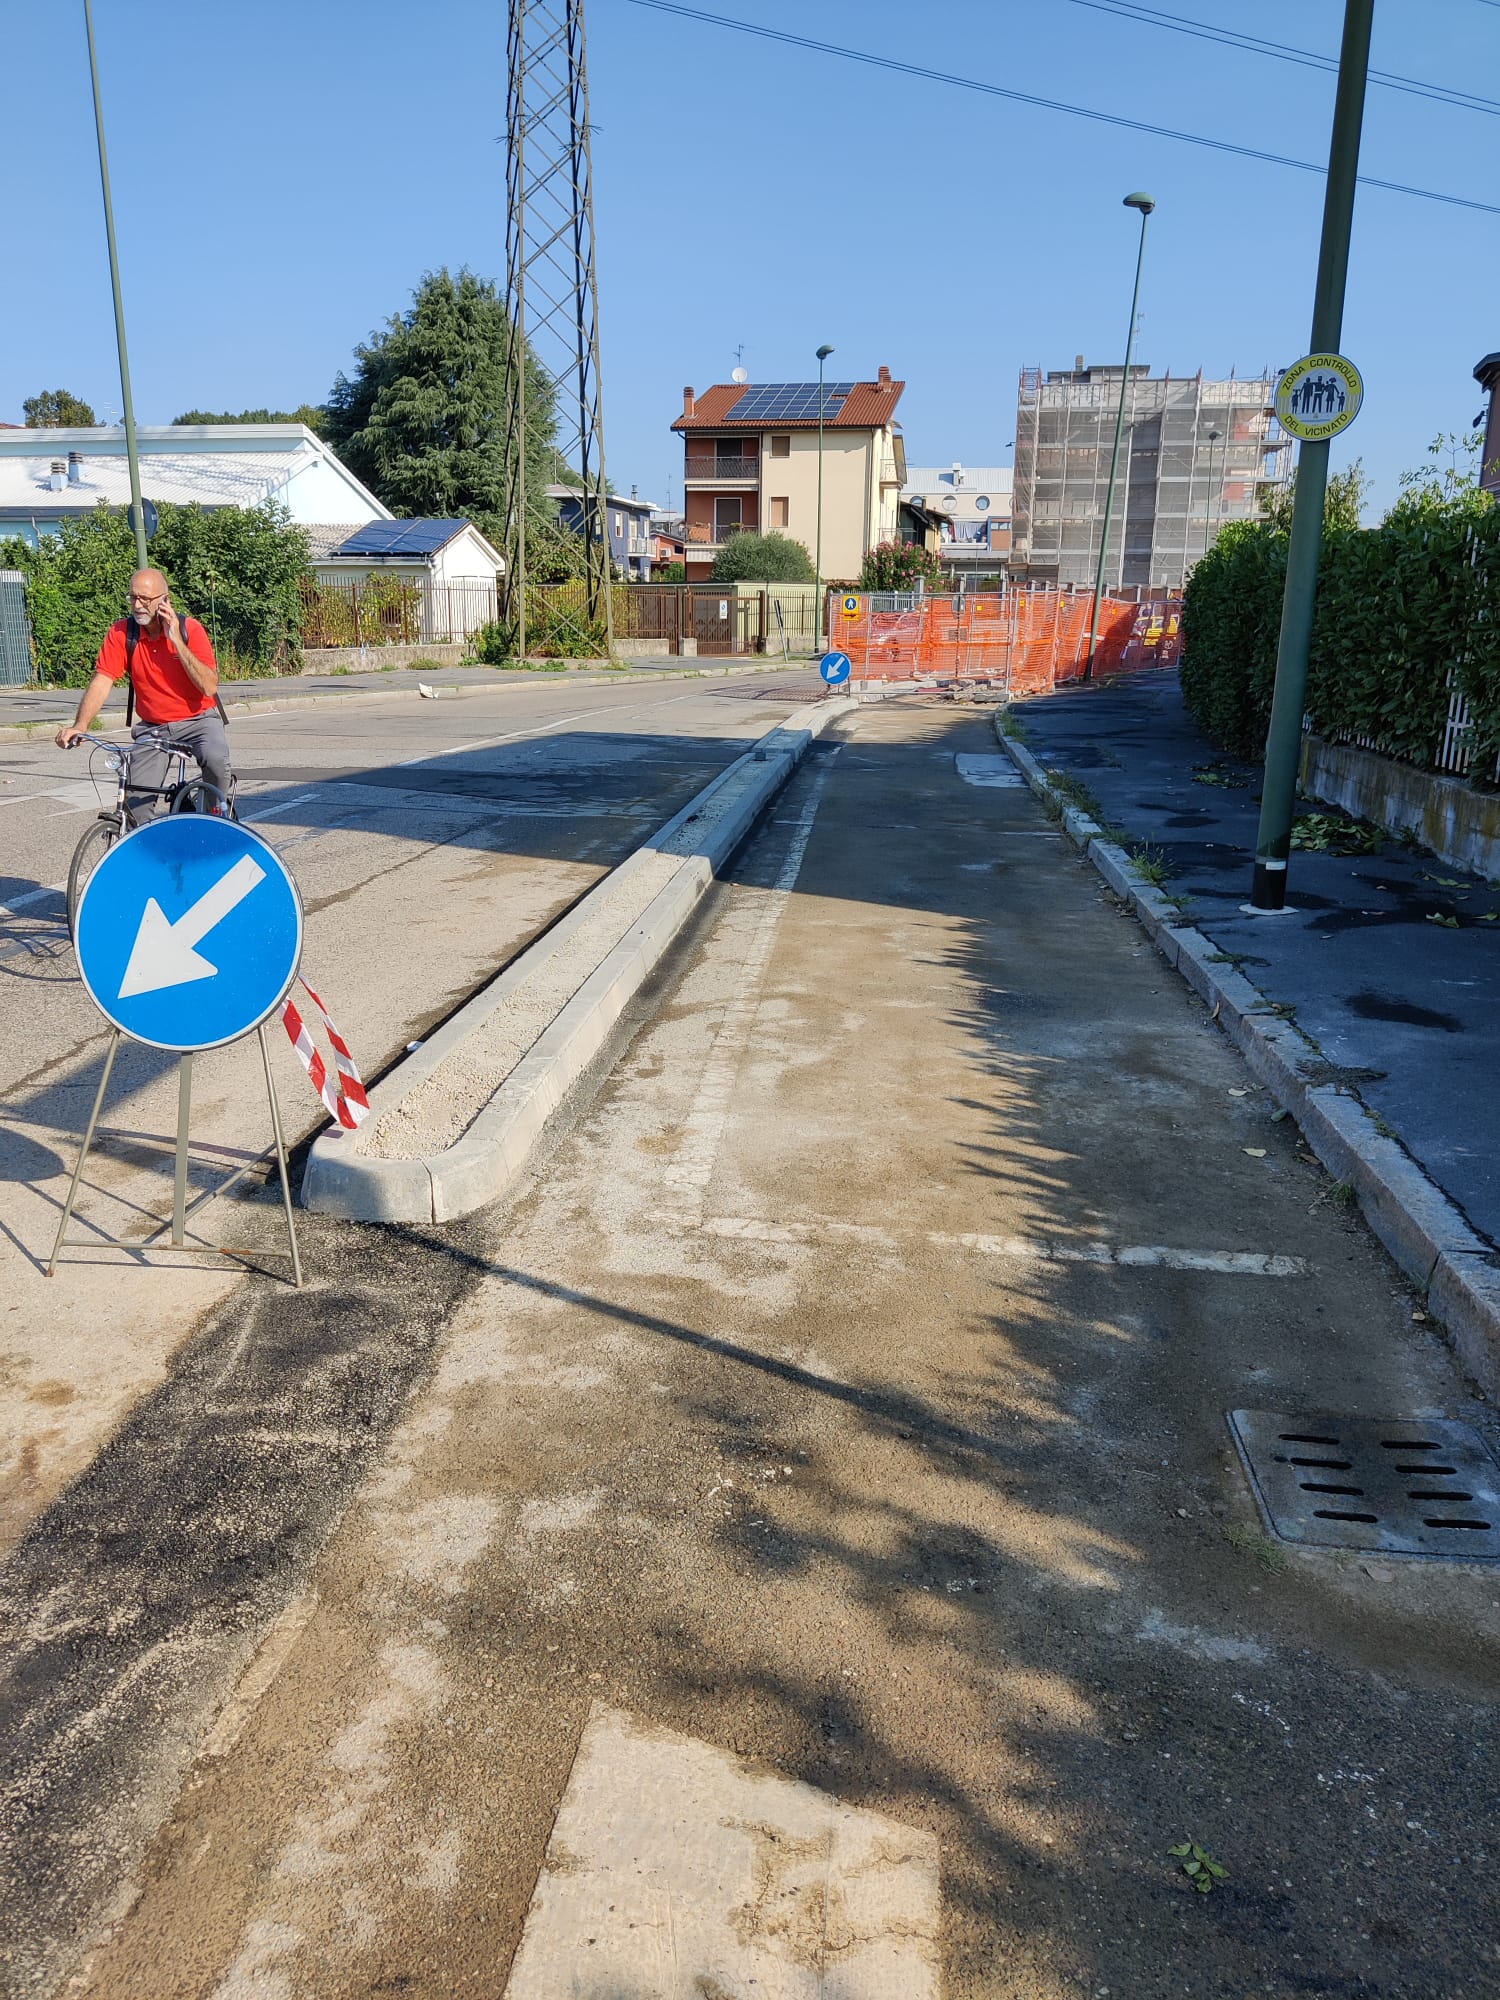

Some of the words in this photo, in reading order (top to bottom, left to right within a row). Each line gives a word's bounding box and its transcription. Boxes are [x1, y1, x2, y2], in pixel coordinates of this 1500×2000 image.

[1283, 366, 1306, 391] ZONA
[1309, 358, 1357, 388] CONTROLLO
[1284, 415, 1299, 432] DEL
[1305, 413, 1348, 436] VICINATO
